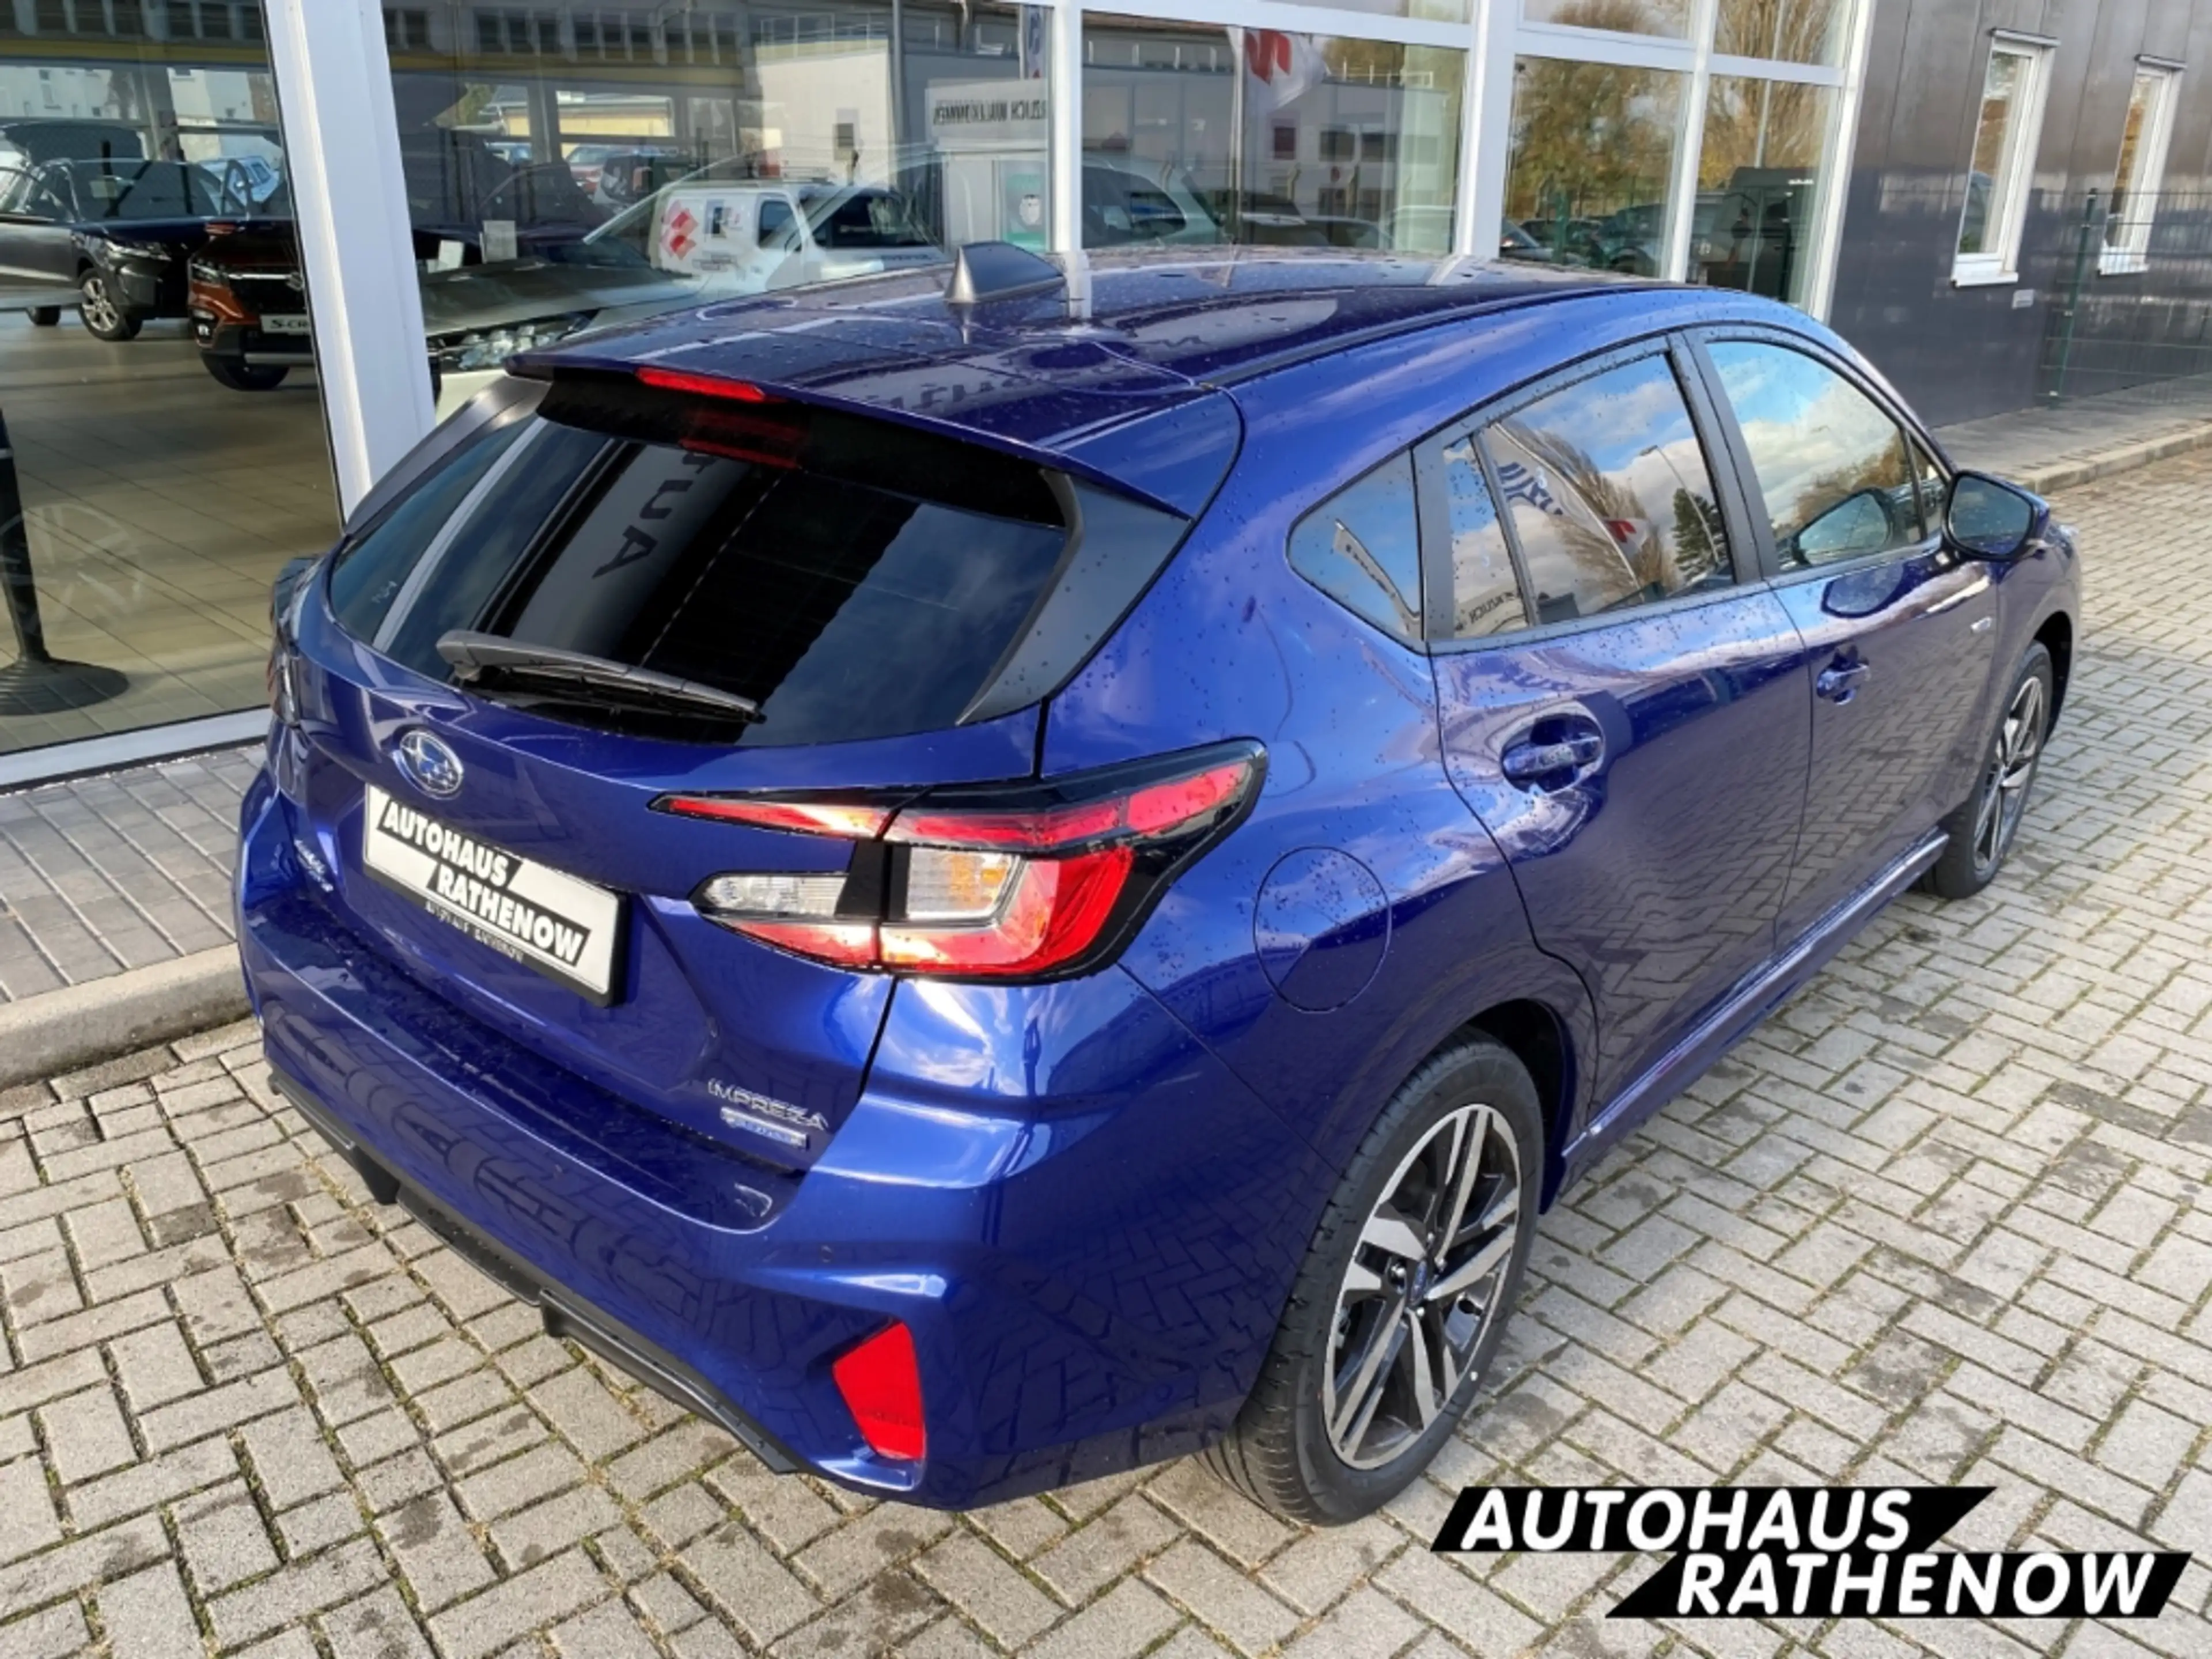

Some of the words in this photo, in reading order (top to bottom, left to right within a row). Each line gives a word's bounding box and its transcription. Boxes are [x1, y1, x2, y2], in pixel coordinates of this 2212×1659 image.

[382, 801, 509, 887] AUTOHAUS
[437, 864, 584, 962] RATHENOW
[707, 1078, 829, 1131] IMPREZA
